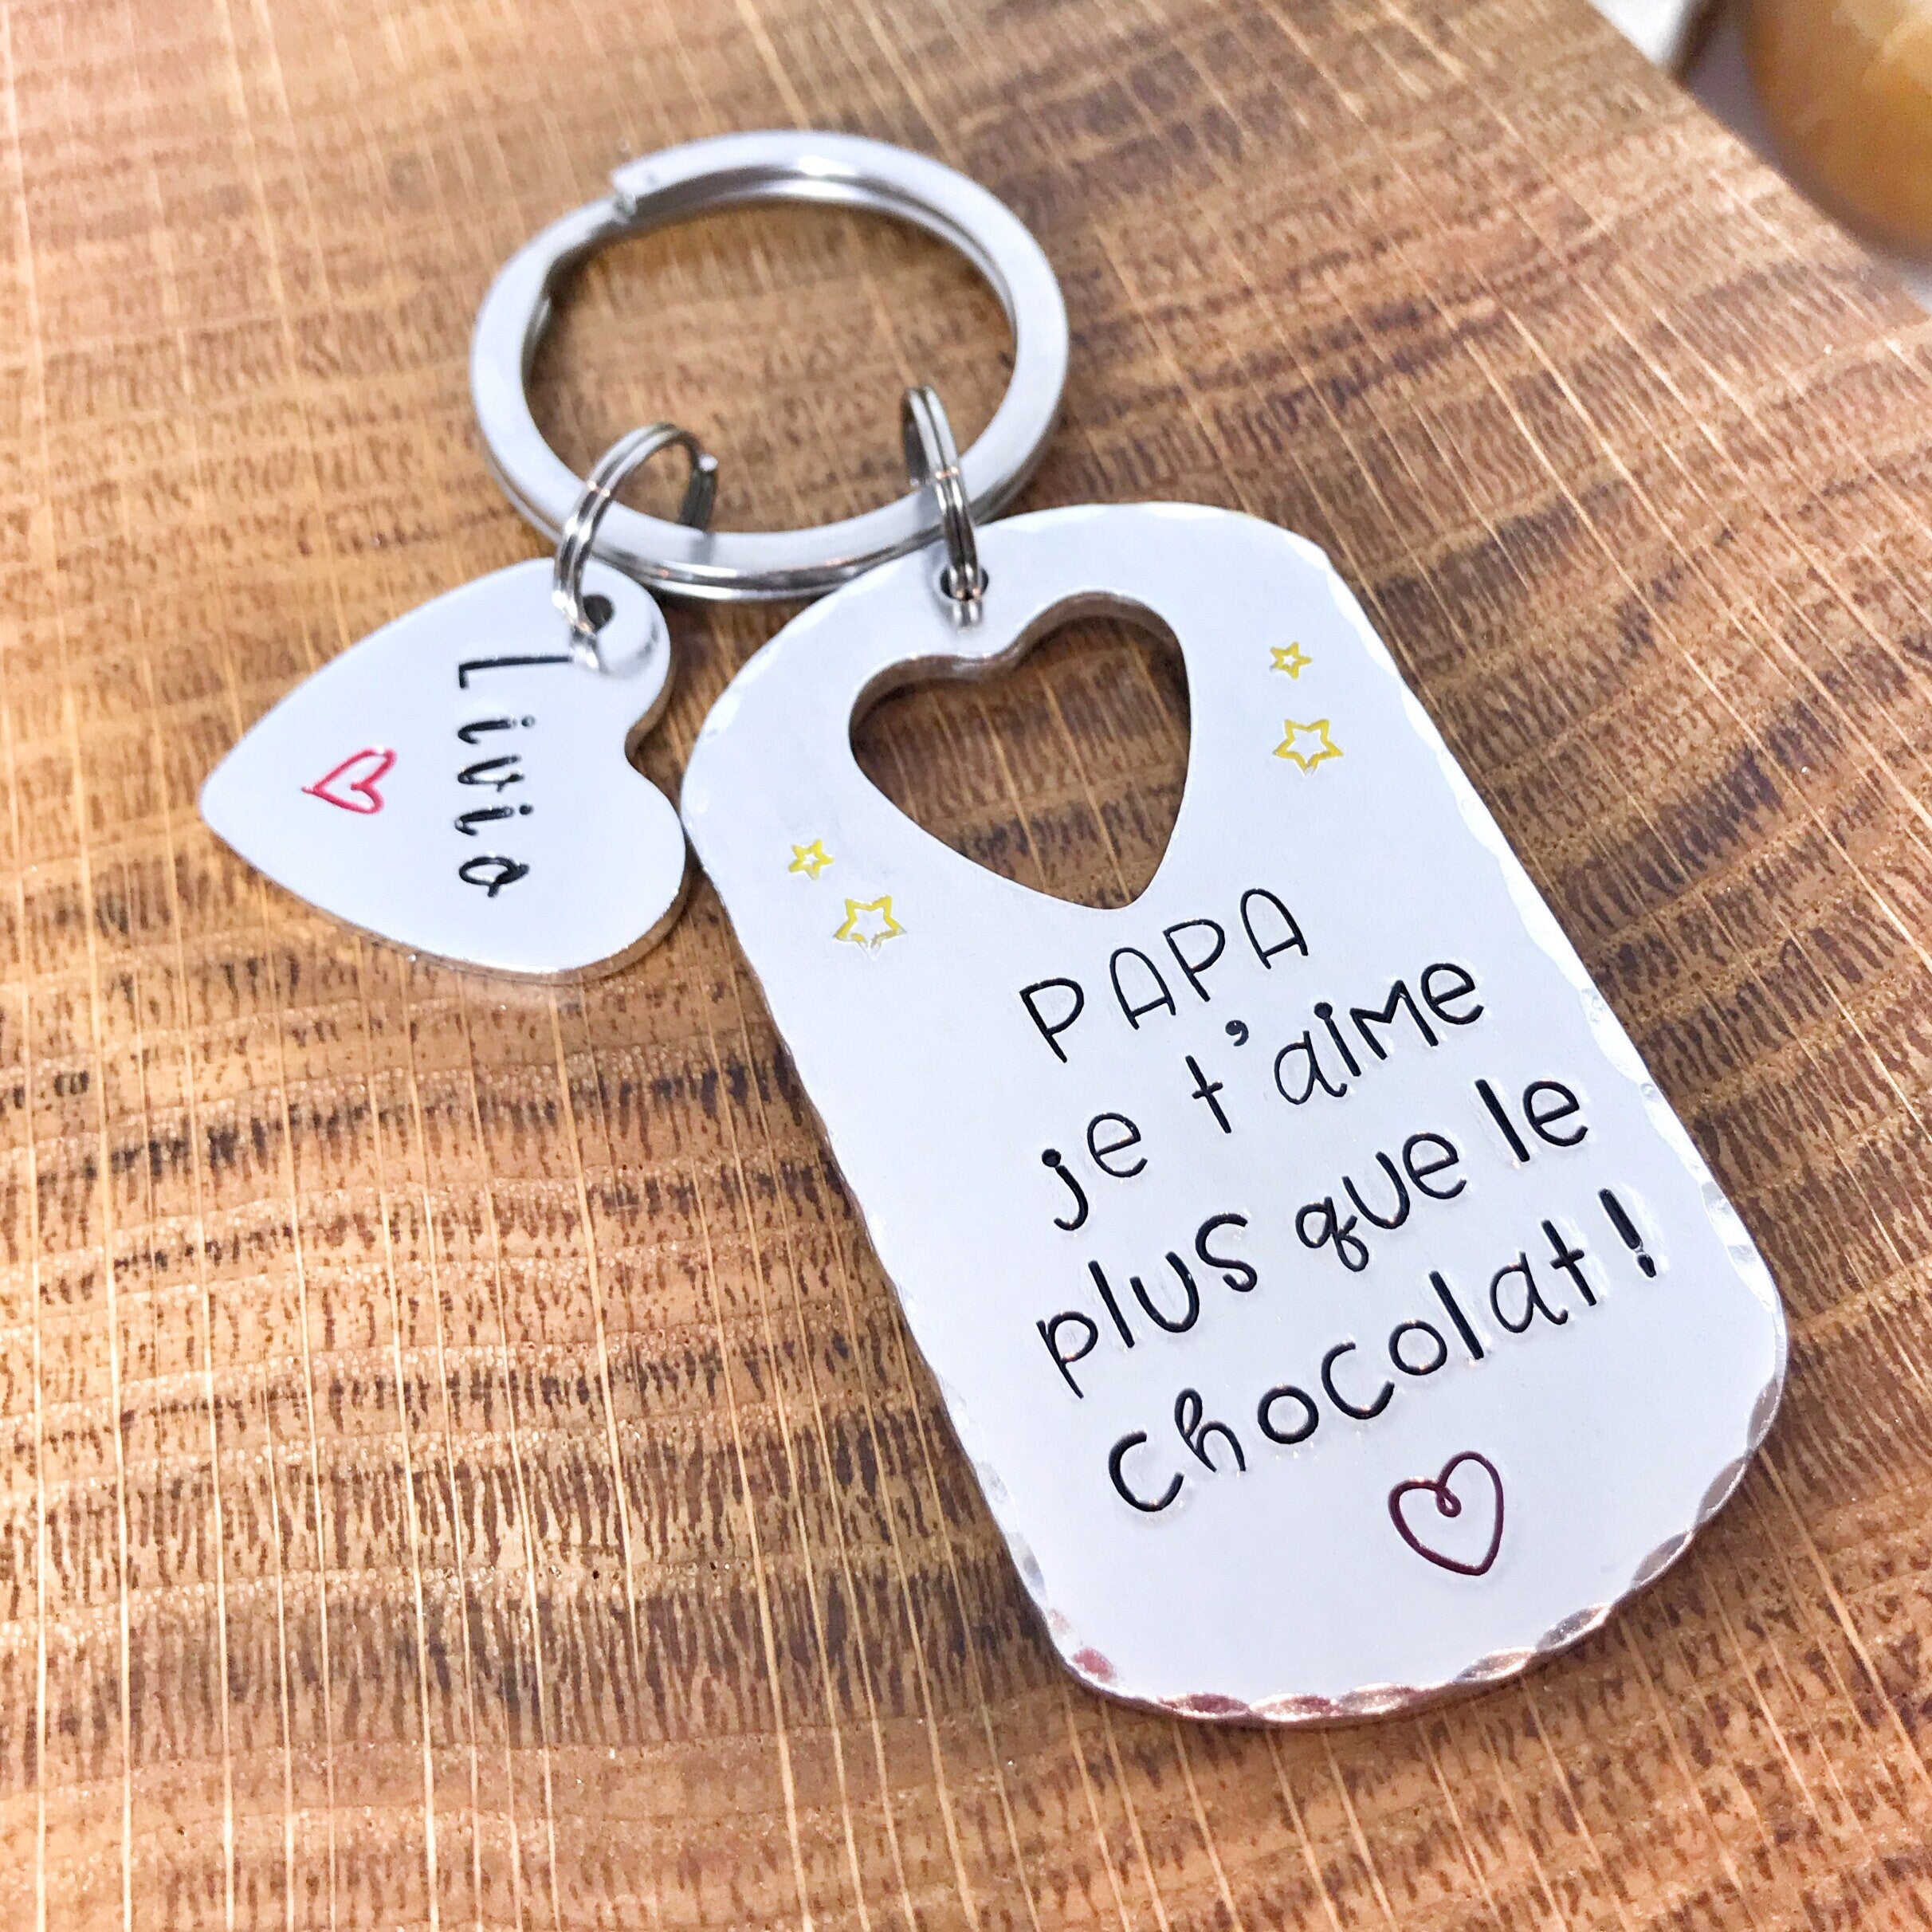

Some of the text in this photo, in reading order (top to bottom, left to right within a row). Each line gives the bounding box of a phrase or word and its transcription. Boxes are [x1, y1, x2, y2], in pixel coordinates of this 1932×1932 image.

[1019, 888, 1310, 1064] PAPA
[1035, 1078, 1589, 1400] plus que le
[1041, 1112, 1149, 1231] je
